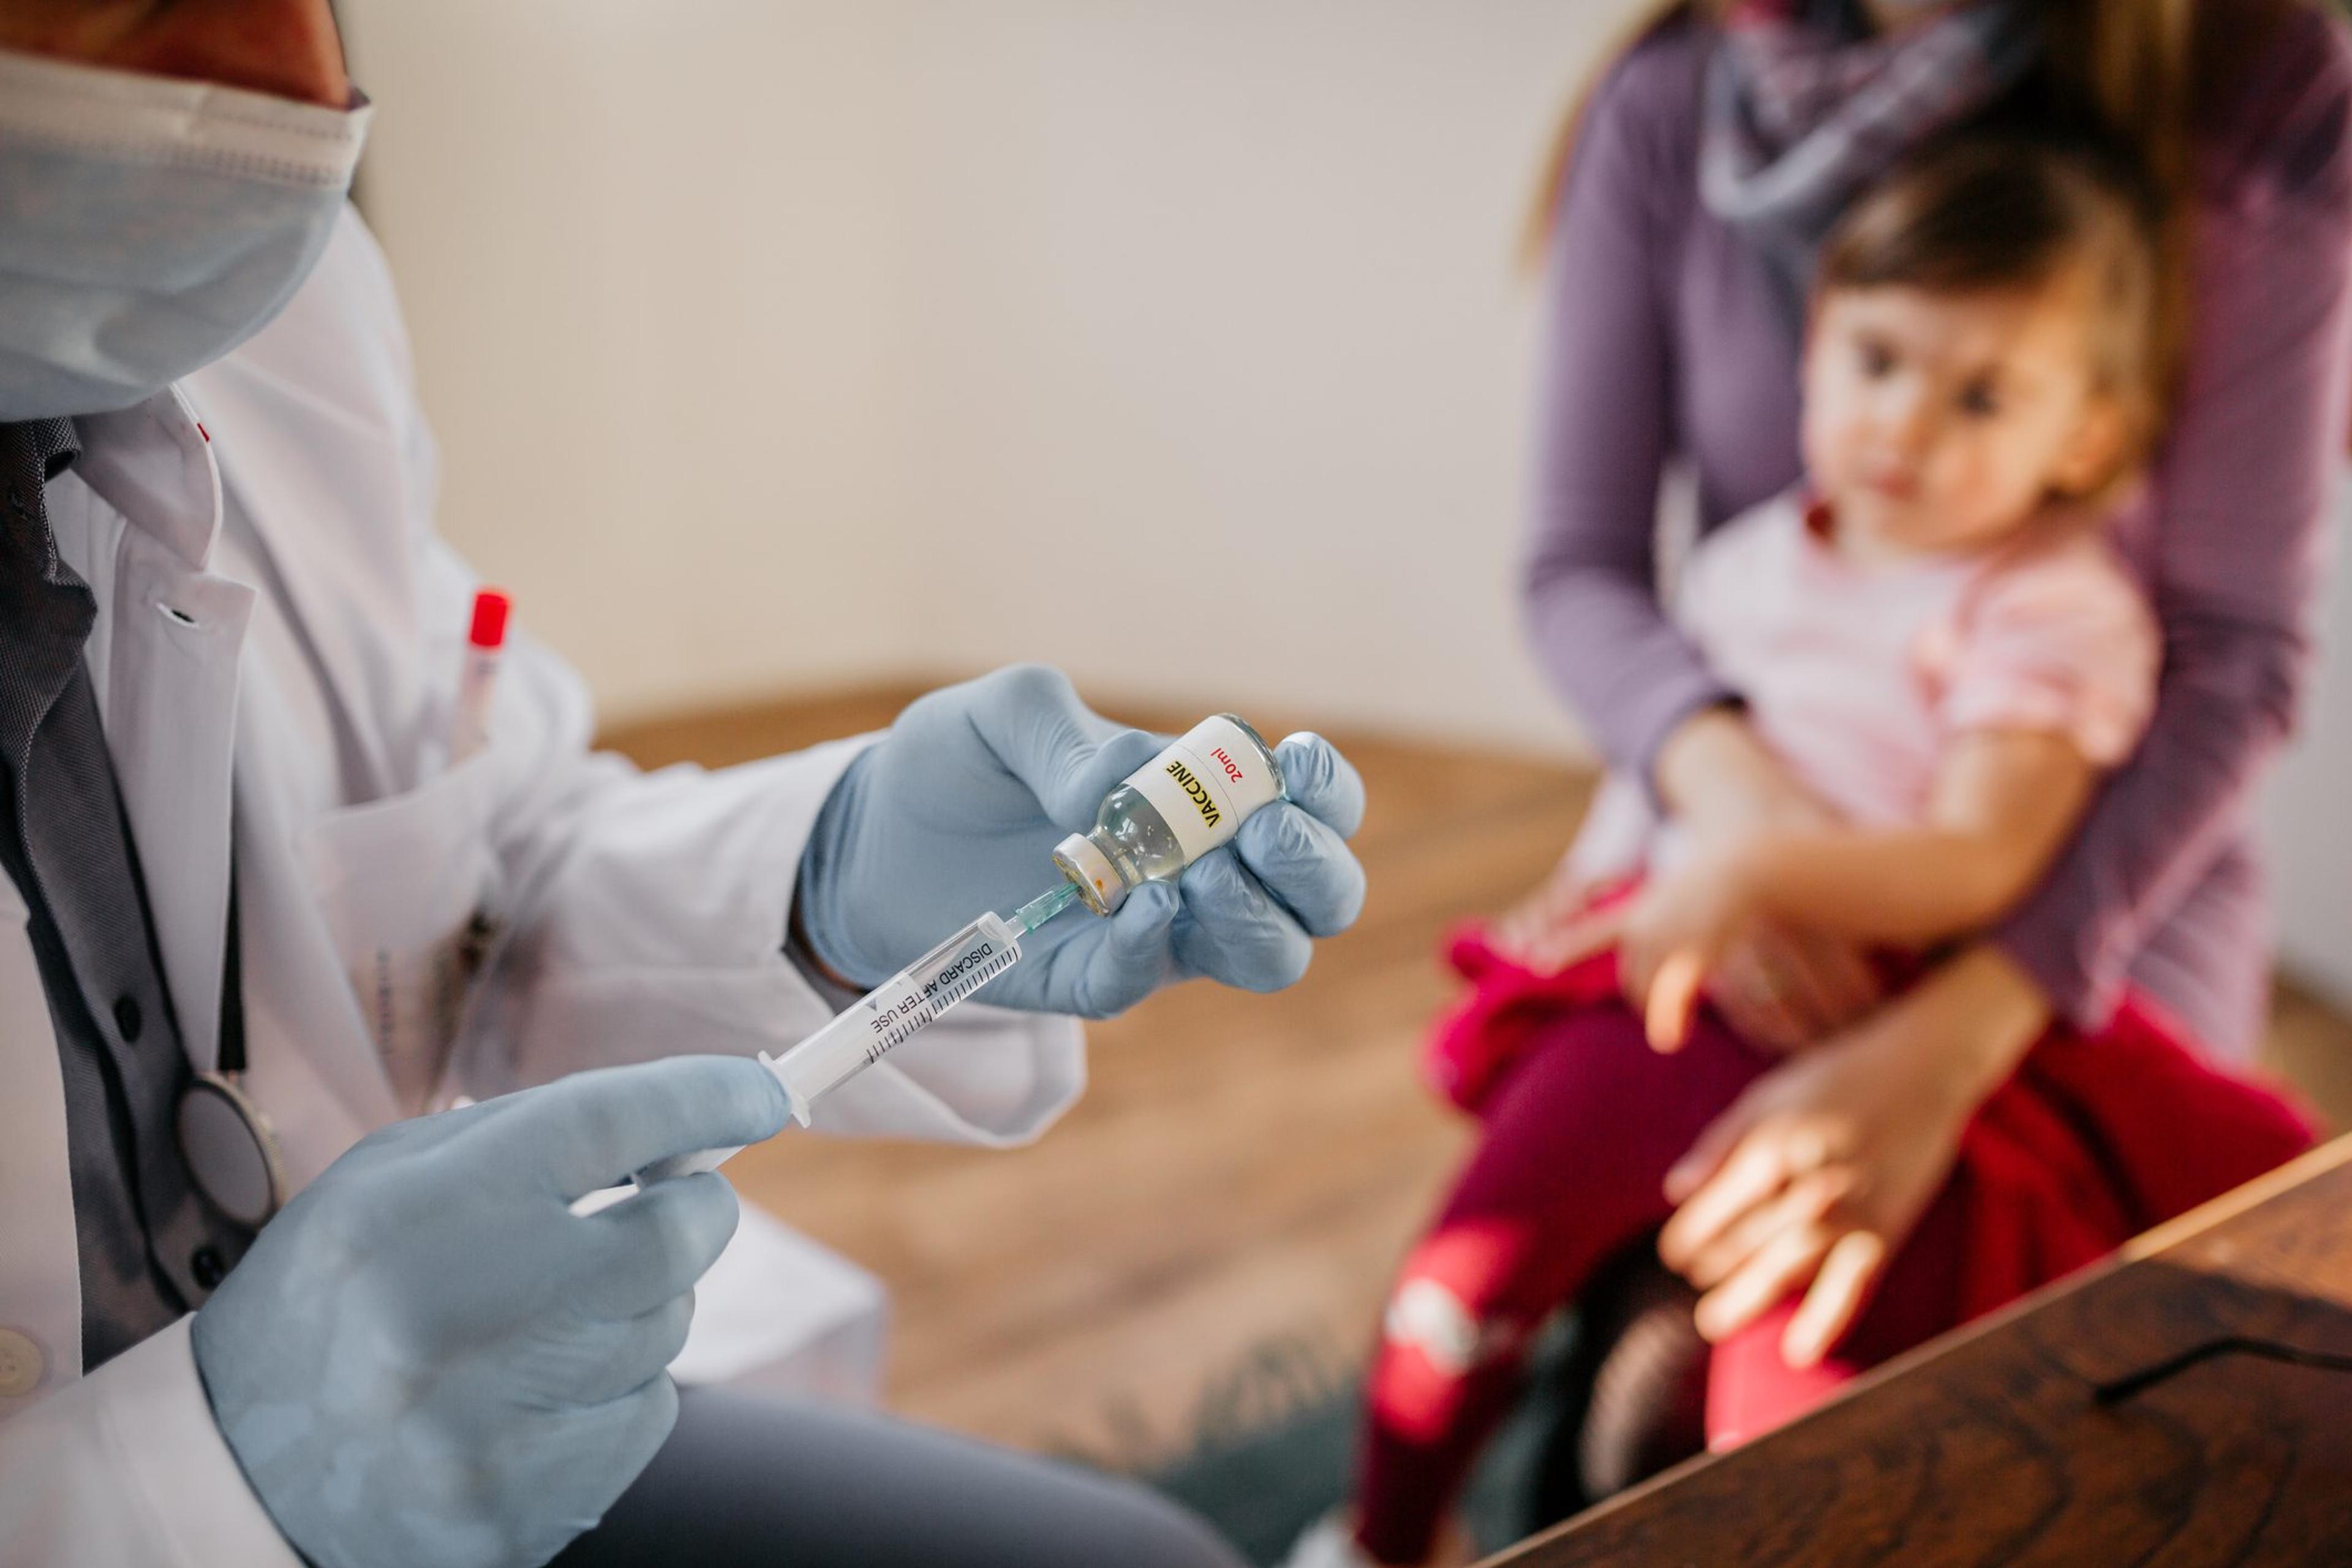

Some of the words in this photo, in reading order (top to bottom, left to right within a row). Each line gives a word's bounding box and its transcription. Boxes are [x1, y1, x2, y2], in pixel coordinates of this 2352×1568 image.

[1211, 748, 1243, 783] 20ml
[1166, 761, 1220, 827] VACCINE
[940, 943, 993, 985] DISCARD
[897, 979, 938, 1014] AFTER
[870, 1009, 899, 1033] USE
